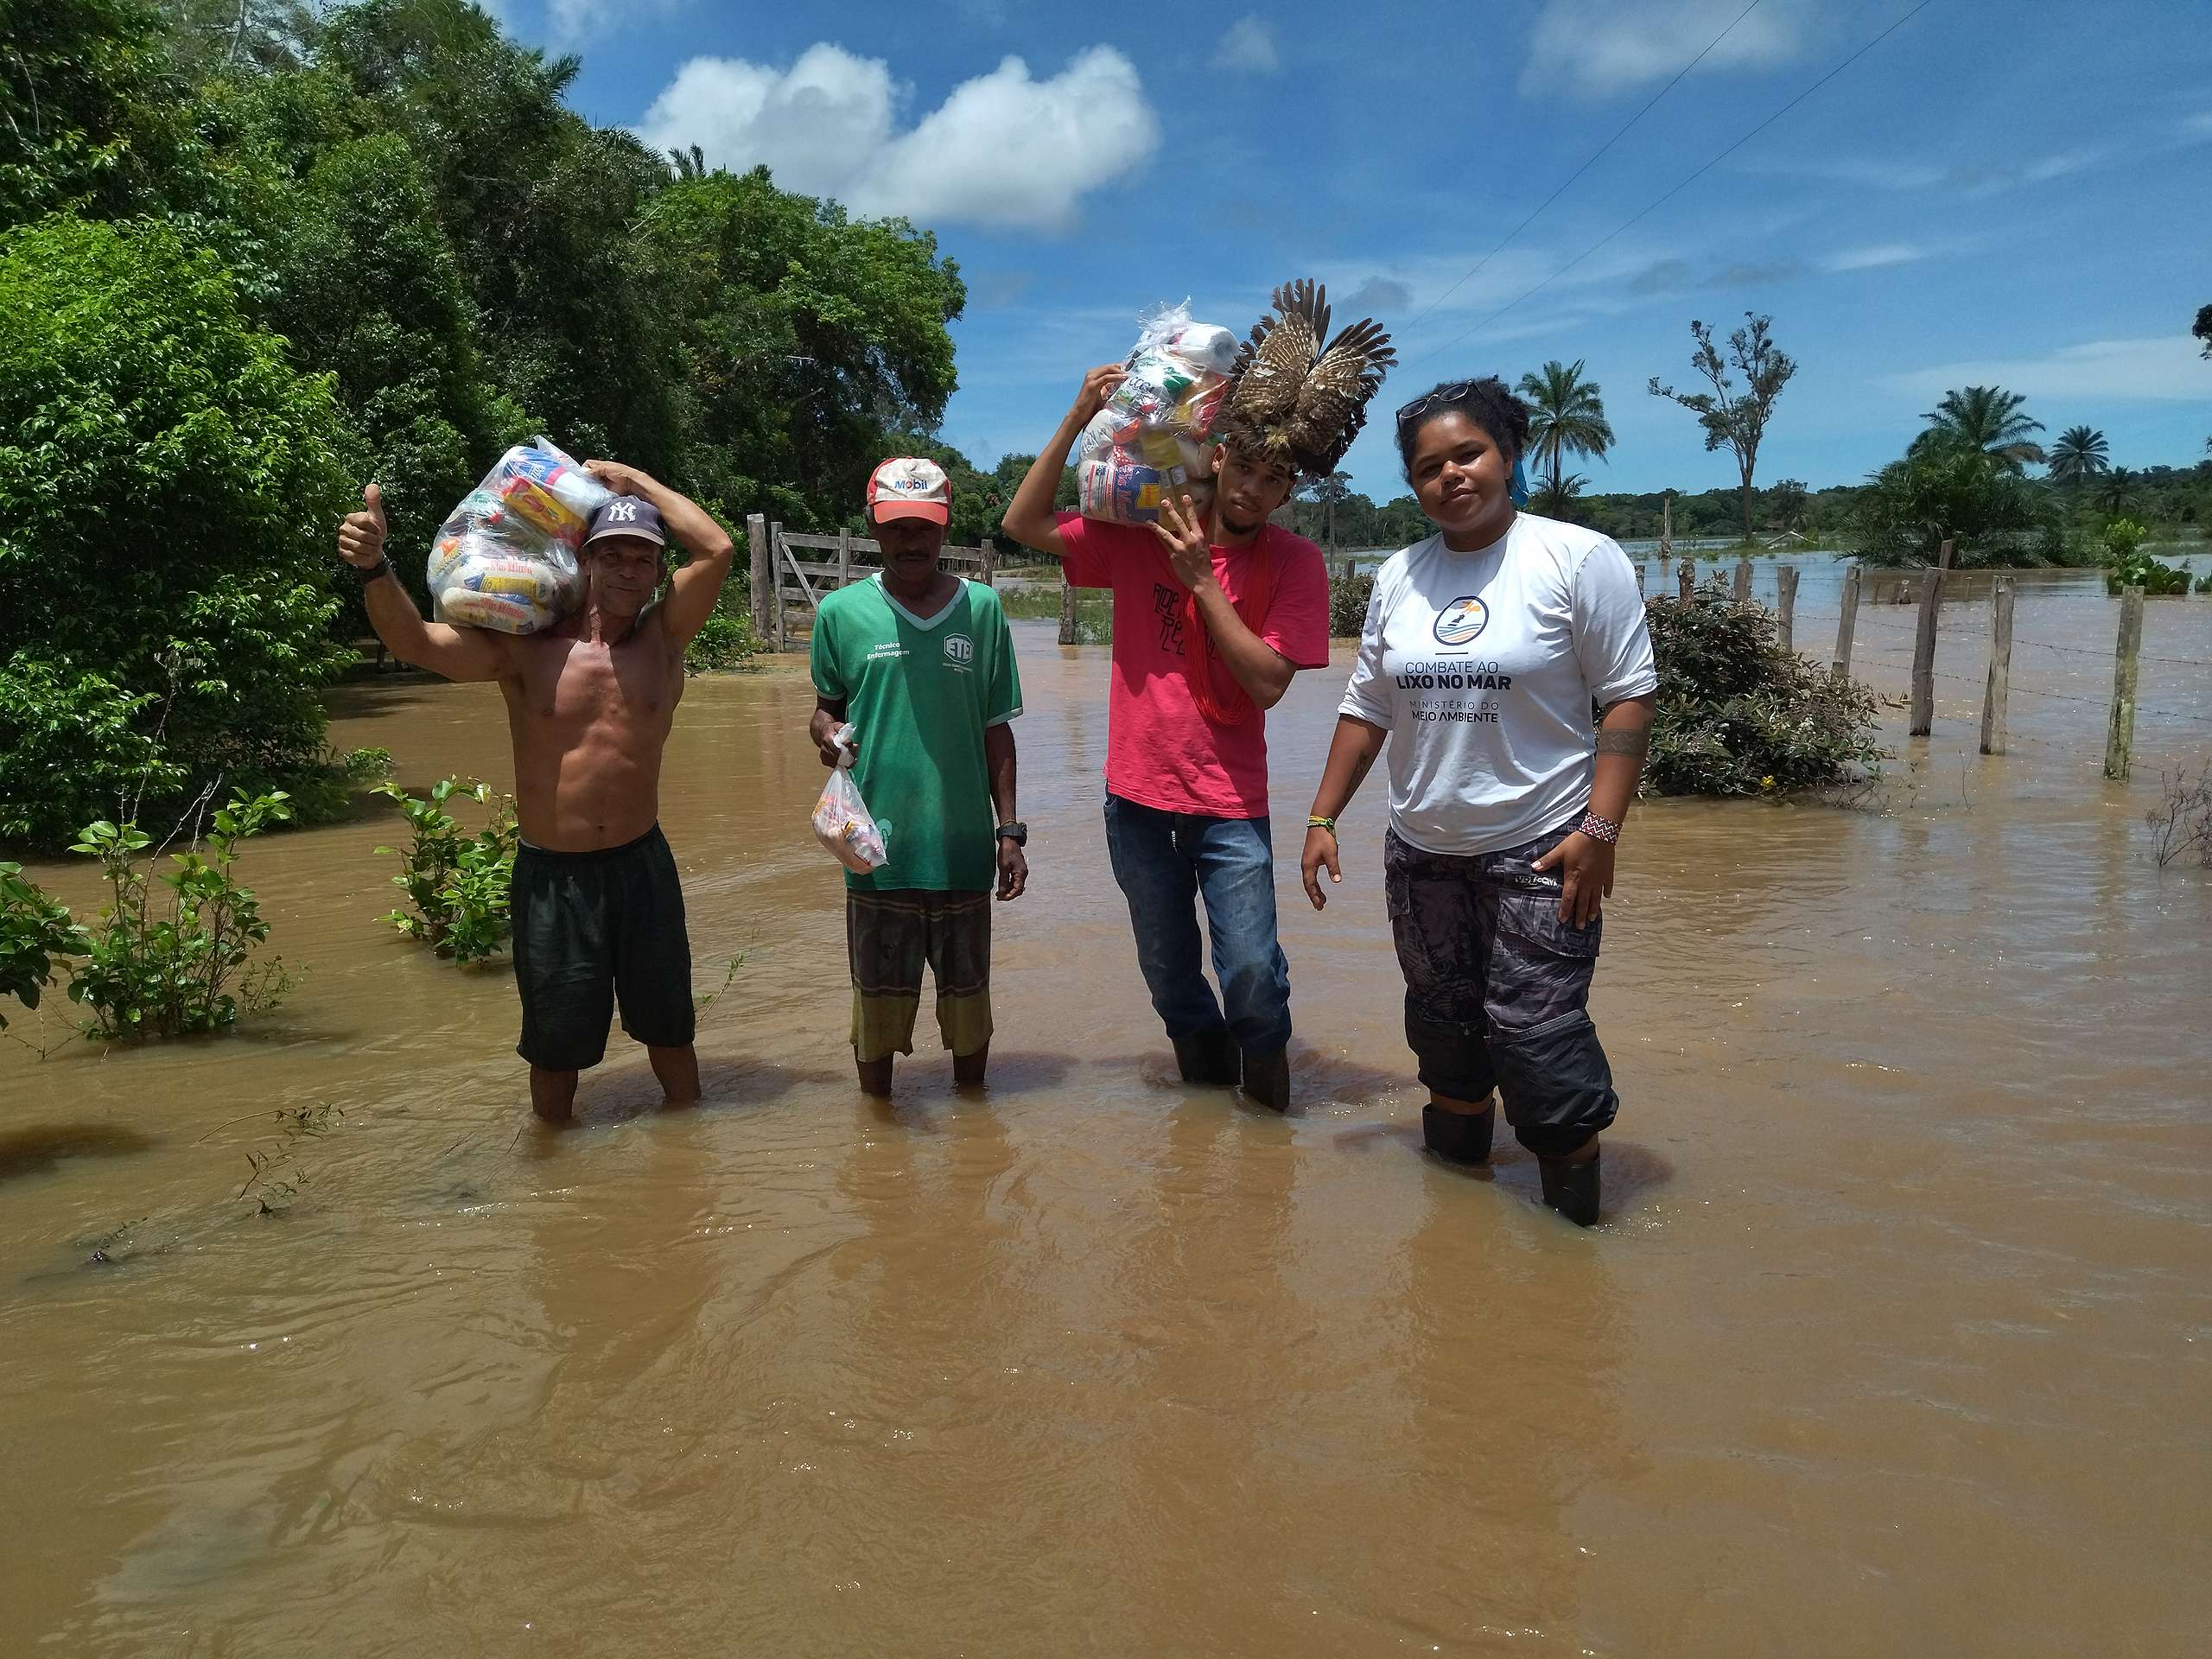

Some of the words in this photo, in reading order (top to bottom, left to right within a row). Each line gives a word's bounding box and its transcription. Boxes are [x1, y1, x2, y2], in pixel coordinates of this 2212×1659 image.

[894, 478, 928, 490] Mobil
[607, 501, 637, 523] NY
[874, 642, 900, 651] Técnico
[867, 650, 910, 660] Enfermagem
[1405, 661, 1473, 674] COMBATE
[1476, 661, 1498, 674] AO
[1395, 674, 1434, 690] LIXO
[1437, 674, 1464, 690] NO
[1467, 674, 1512, 690] MAR
[1409, 699, 1475, 710] MINISTÉRIO
[1481, 702, 1499, 710] DO
[1411, 710, 1437, 721] MEIO
[1439, 712, 1498, 723] AMBIENTE
